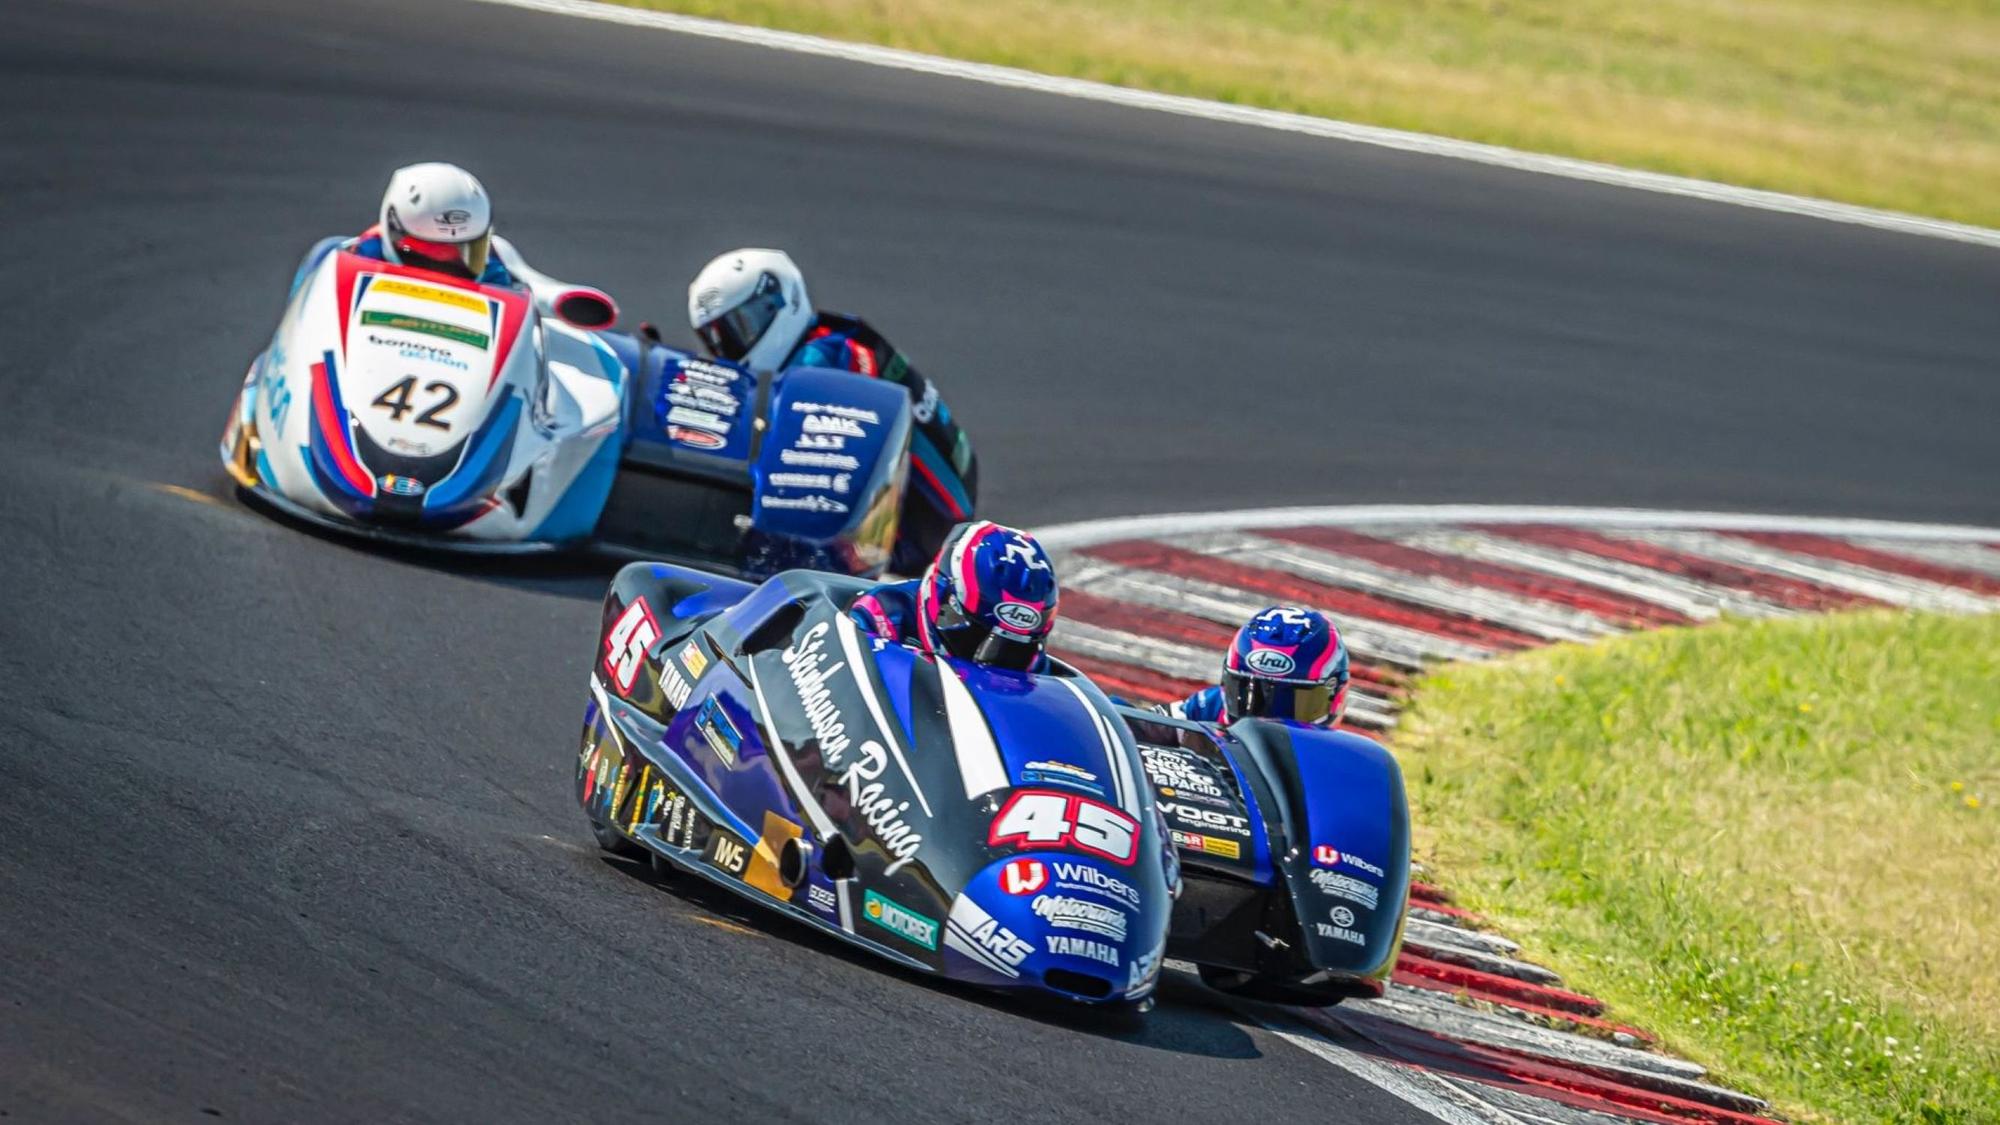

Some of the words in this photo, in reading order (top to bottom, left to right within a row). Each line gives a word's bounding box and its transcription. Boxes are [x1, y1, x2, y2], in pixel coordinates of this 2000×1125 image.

[370, 374, 460, 431] 42
[1000, 605, 1038, 624] Arai
[606, 599, 659, 692] 45
[1250, 652, 1289, 669] Arai
[782, 621, 851, 764] Steinhausen
[838, 740, 922, 877] Racing
[1169, 777, 1222, 797] PAGID
[994, 792, 1137, 862] 45
[1155, 800, 1248, 828] VOGT
[1177, 816, 1251, 837] engineering
[1340, 851, 1384, 877] Wilbers
[1052, 862, 1140, 905] Wilbers
[881, 902, 936, 946] MOTOREX
[1316, 922, 1366, 947] YAMAHA
[970, 918, 1036, 967] ARS
[1045, 934, 1120, 968] YAMAHA
